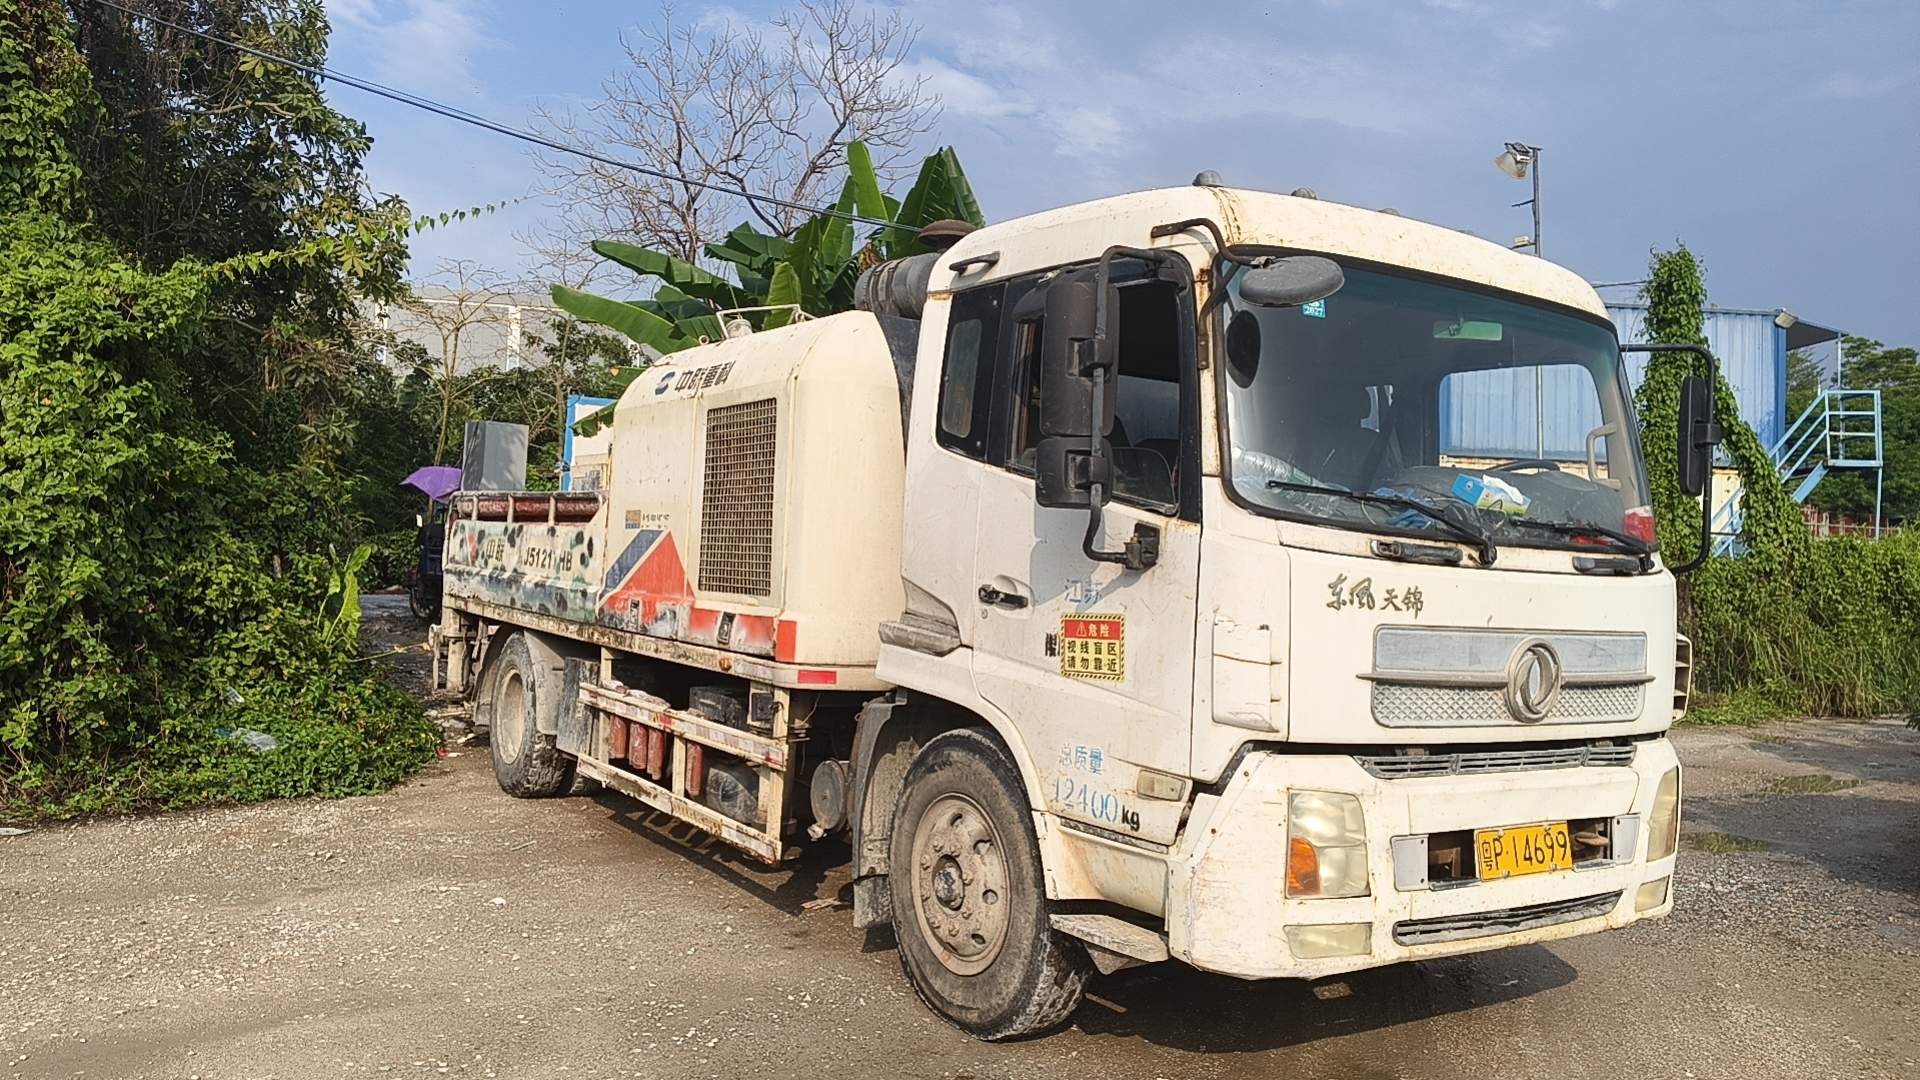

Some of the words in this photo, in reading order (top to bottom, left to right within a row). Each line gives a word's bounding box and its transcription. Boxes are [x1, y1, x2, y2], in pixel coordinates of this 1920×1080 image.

[524, 547, 572, 572] J5121HB
[1088, 623, 1110, 638] 危险
[1067, 640, 1117, 656] 视线盲区
[1067, 656, 1117, 672] 请勿靠近
[1059, 742, 1103, 775] 总质量
